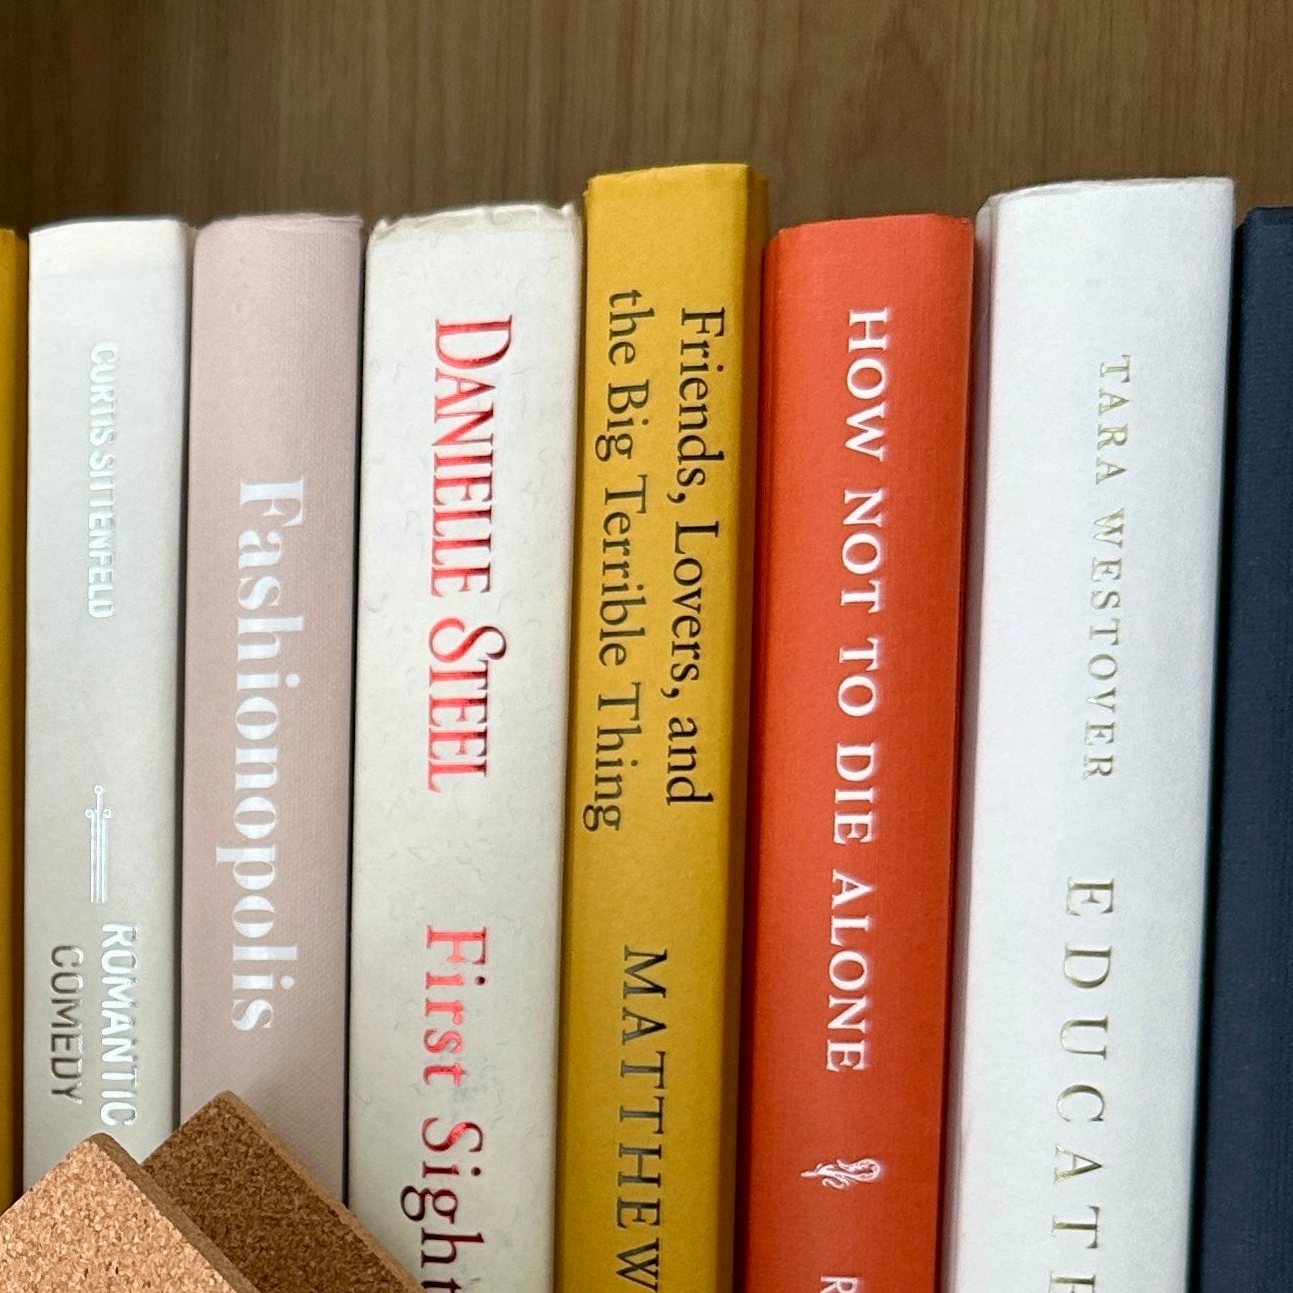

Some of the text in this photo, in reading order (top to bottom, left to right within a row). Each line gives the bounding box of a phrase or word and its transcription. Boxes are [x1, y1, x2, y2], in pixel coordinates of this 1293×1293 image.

[88, 340, 118, 619] CURTIS SITTENFELD
[582, 289, 655, 833] the Big Terrible Thing
[660, 306, 726, 806] Friends, Lovers, and
[1083, 354, 1132, 781] TARA WESTOVER
[216, 475, 304, 1032] Fashionopolis
[825, 307, 888, 1073] HOW NOT TO DIE ALONE
[49, 944, 86, 1105] COMEDY
[100, 922, 140, 1128] ROMANTIC
[423, 925, 488, 1087] First
[614, 945, 668, 1293] MATTHEW
